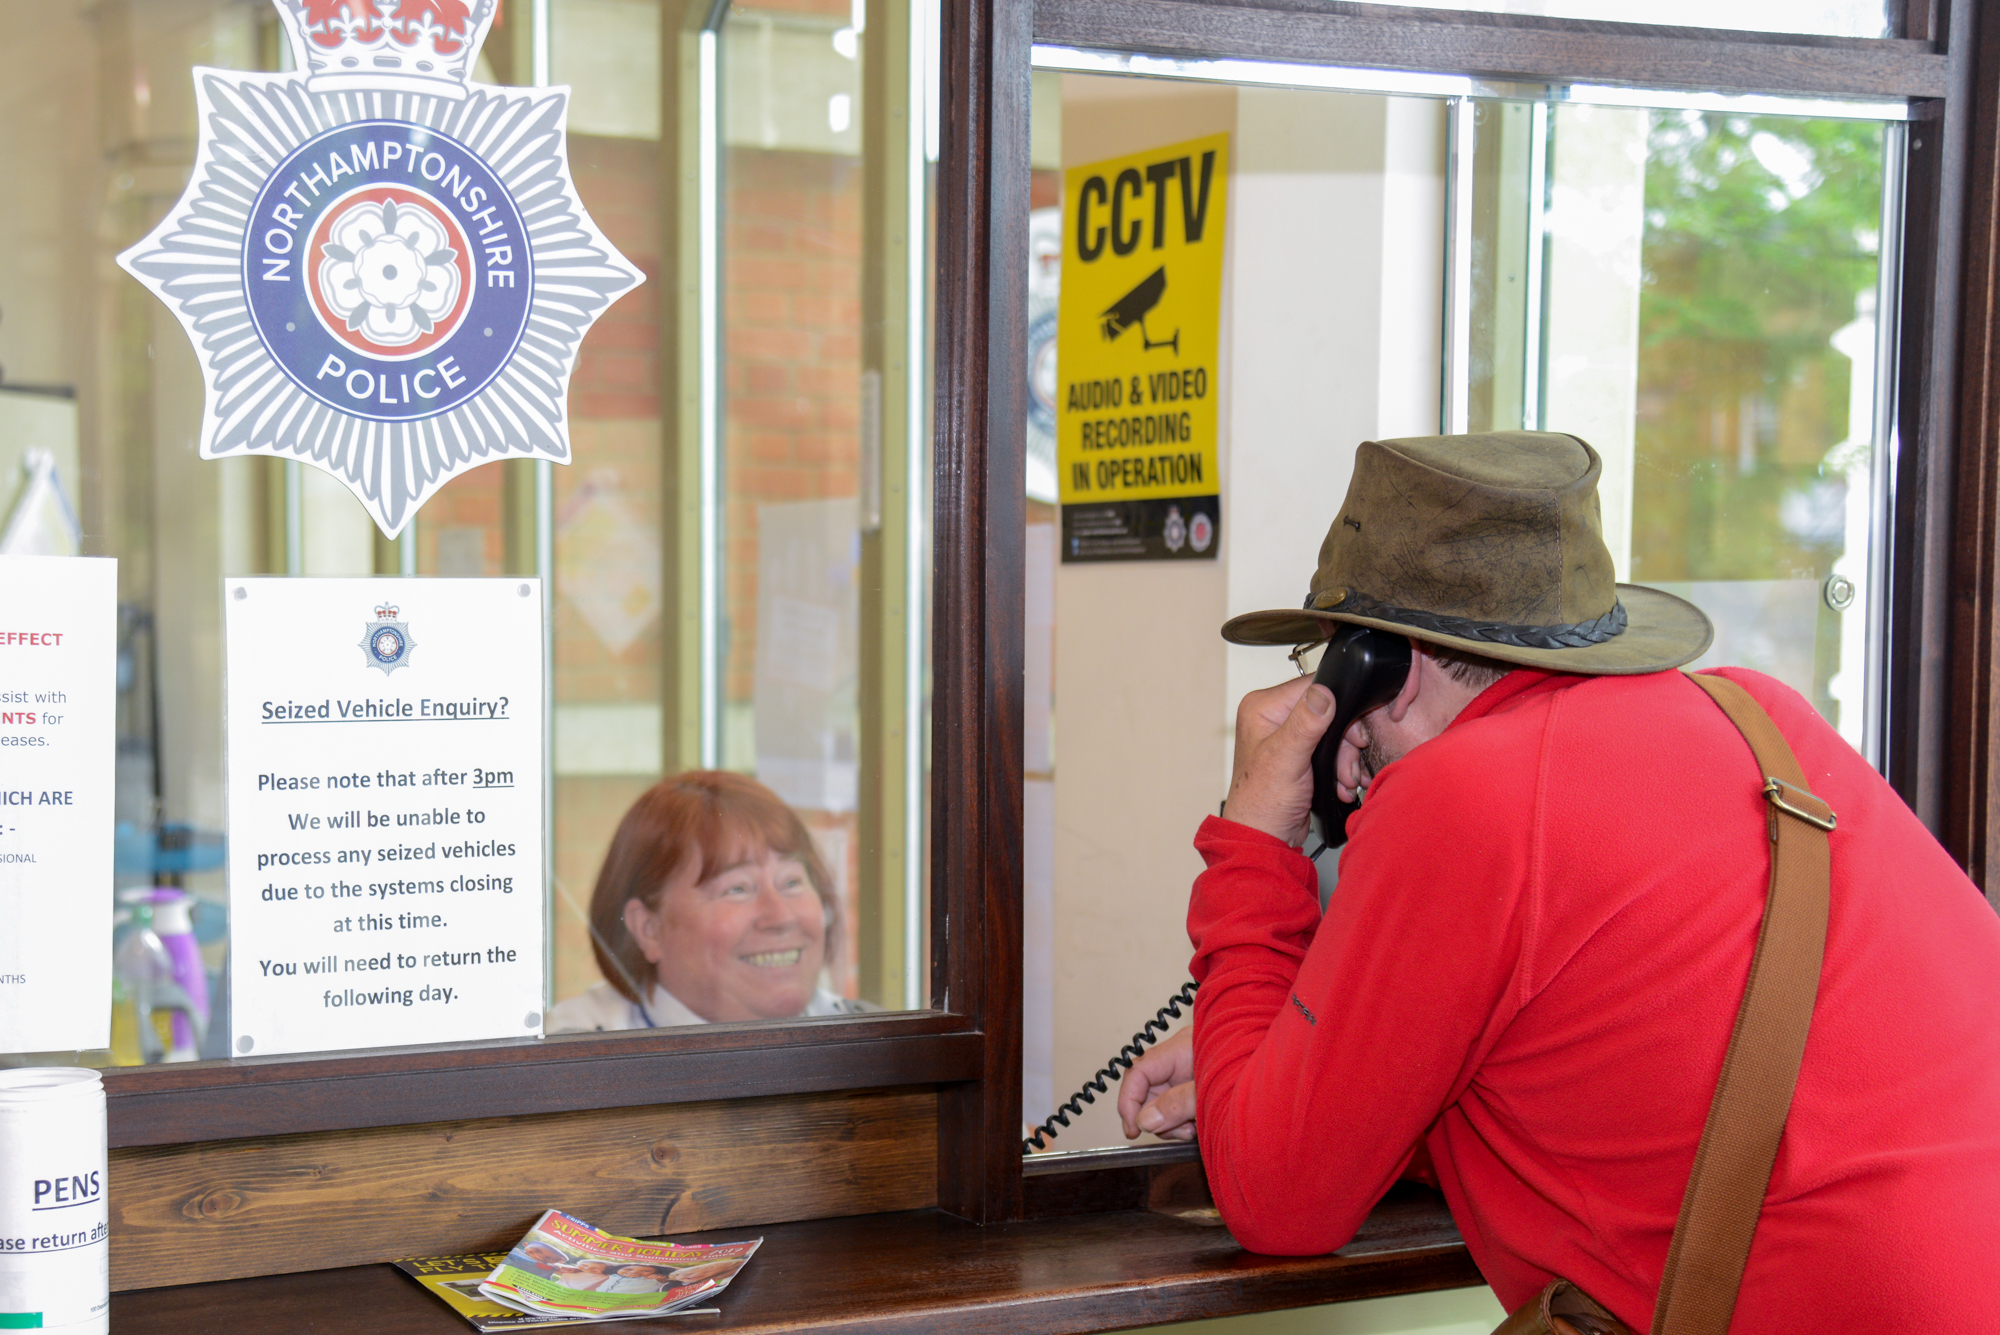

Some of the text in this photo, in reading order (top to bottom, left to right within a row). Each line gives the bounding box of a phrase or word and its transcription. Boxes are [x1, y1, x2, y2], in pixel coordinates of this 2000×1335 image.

[262, 140, 515, 289] NORTHAMPTONSHIRE
[1077, 149, 1217, 265] CCTV
[316, 353, 467, 404] POLICE
[1068, 367, 1208, 413] AUDIO & VIDEO
[1081, 411, 1192, 451] RECORDING
[1072, 452, 1204, 492] IN OPERATION
[35, 691, 67, 704] with
[261, 696, 510, 720] Seized Vehicle Enquiry?
[42, 712, 64, 725] for
[258, 768, 514, 791] Please note that after 3pm
[38, 791, 74, 806] ARE
[288, 807, 486, 830] We will be unable to
[257, 839, 516, 871] process any seized vehicles
[261, 874, 514, 901] due to the systems closing
[333, 911, 448, 933] at this time.
[259, 946, 517, 977] You will need to return the
[323, 984, 459, 1008] following day.
[34, 1170, 100, 1205] PENS
[32, 1230, 87, 1250] return
[90, 1222, 109, 1241] afte
[551, 1220, 624, 1252] SUMMER
[627, 1246, 703, 1258] HOLIDAY
[553, 1230, 607, 1253] Activities
[610, 1250, 633, 1258] and
[413, 1258, 481, 1268] LET'S
[419, 1265, 464, 1274] FLY
